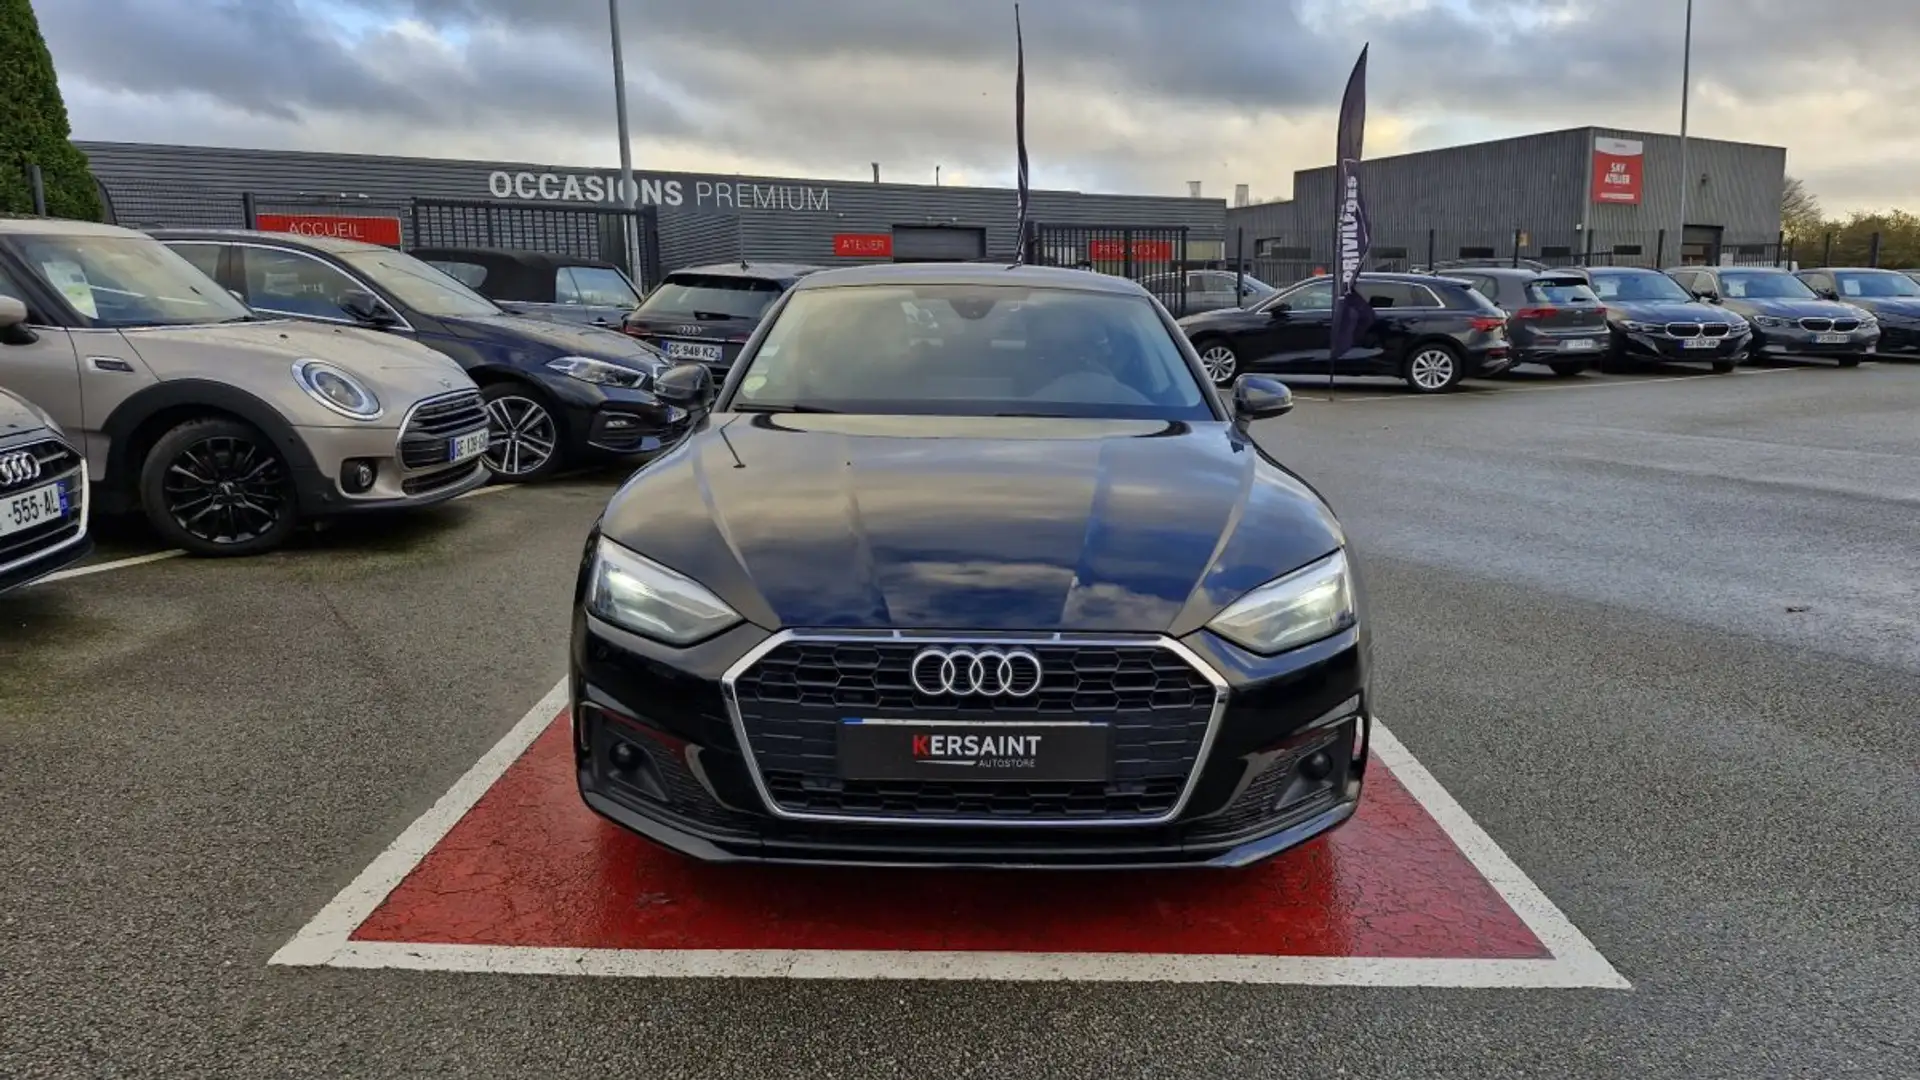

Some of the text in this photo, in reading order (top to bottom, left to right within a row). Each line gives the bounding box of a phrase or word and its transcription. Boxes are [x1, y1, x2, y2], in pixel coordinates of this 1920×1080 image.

[1605, 173, 1630, 184] ATELIER
[489, 171, 829, 211] OCCASIONS PREMIUM
[289, 222, 364, 238] ACCUEIL
[841, 239, 884, 251] ATELIER
[912, 735, 1042, 756] KERSAINT
[979, 759, 1036, 768] AUTOSTORE
